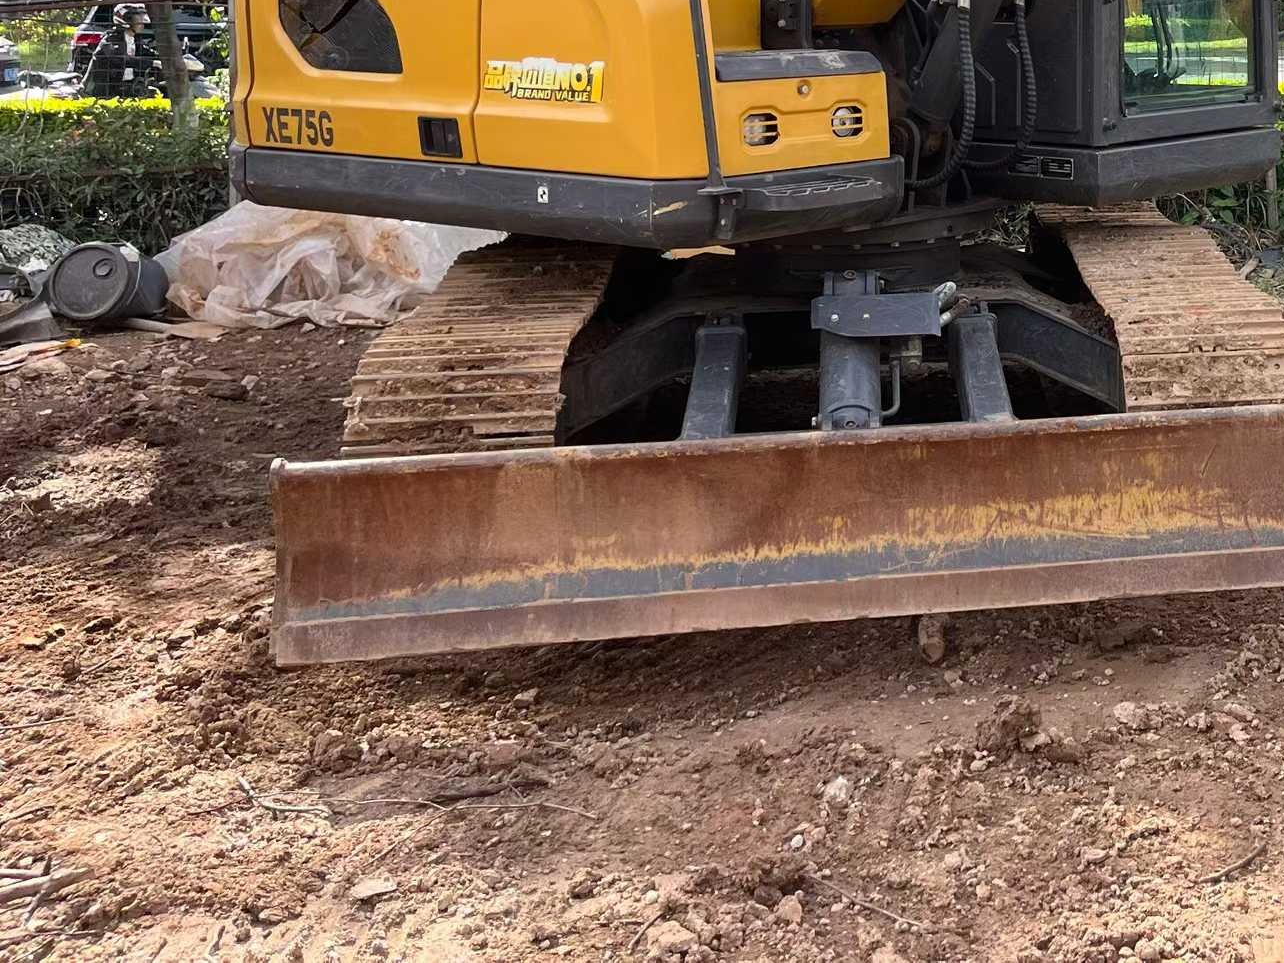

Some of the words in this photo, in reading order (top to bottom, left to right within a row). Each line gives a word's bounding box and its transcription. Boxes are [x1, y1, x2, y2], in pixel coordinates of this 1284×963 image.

[516, 88, 552, 101] BRAND
[555, 90, 590, 103] VALUE
[261, 106, 334, 147] XE75G
